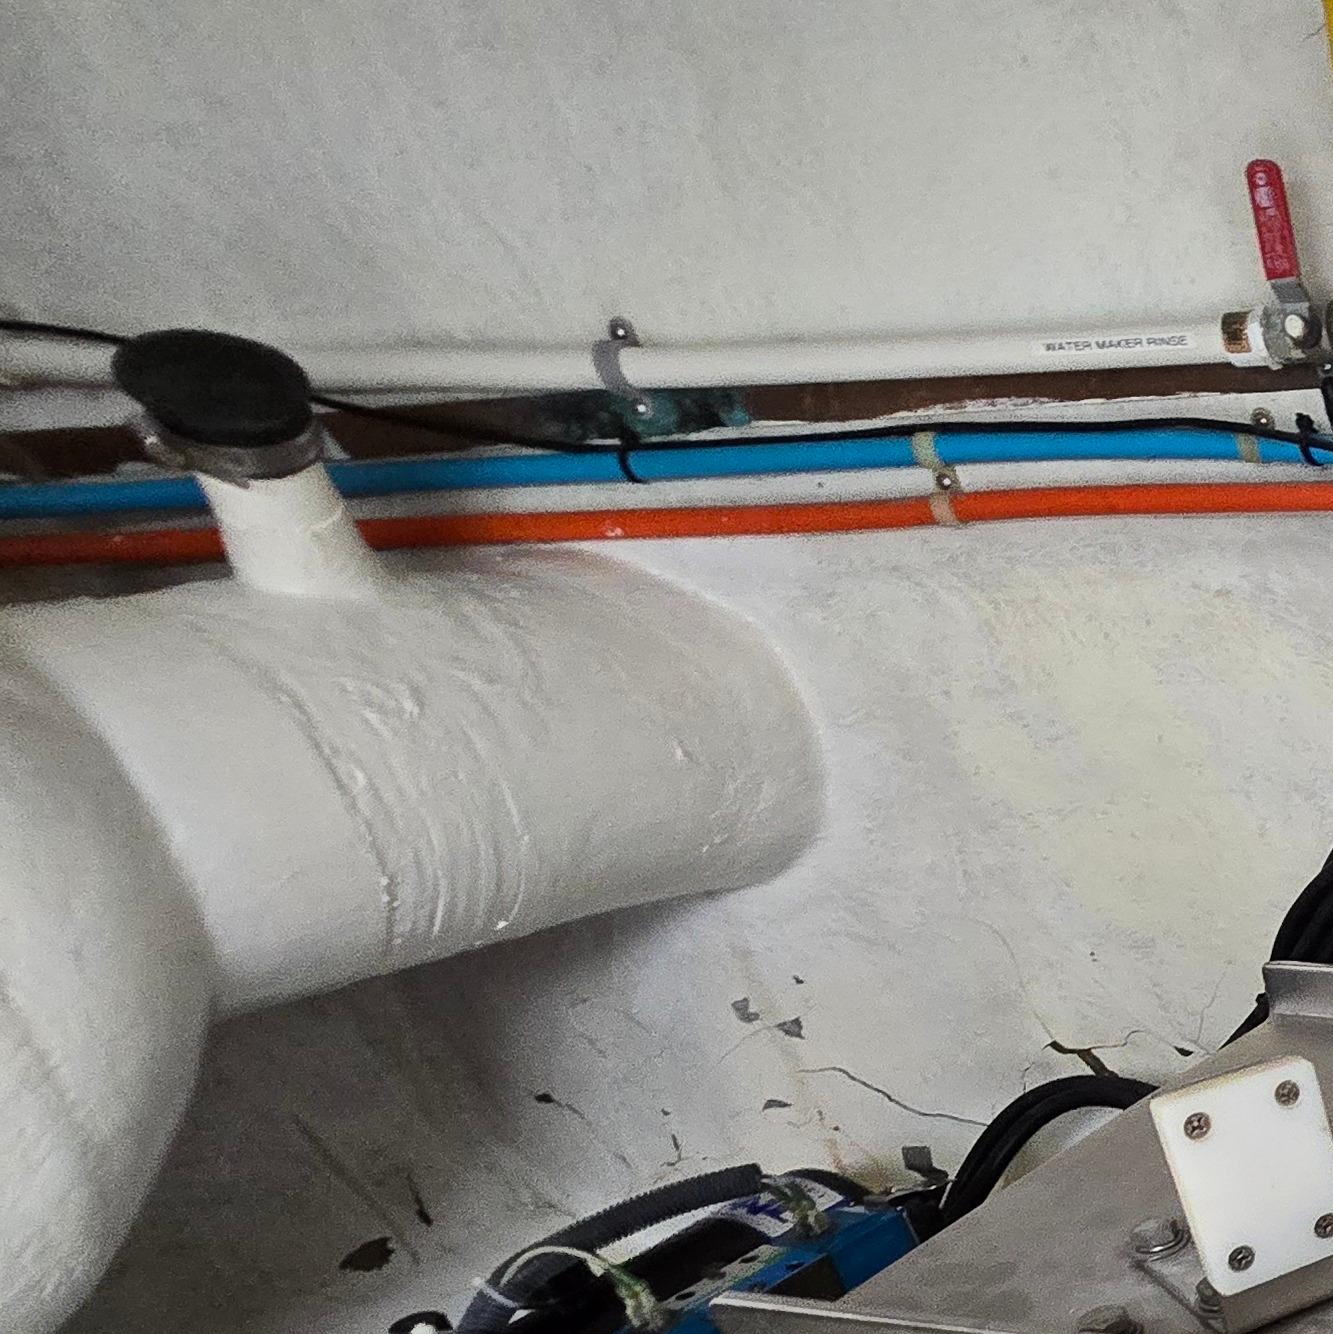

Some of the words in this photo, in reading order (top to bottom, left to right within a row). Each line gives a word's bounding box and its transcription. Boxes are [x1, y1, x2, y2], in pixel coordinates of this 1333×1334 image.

[1044, 340, 1092, 351] WATER
[1095, 337, 1144, 350] MAKER
[1146, 335, 1188, 347] RINSE
